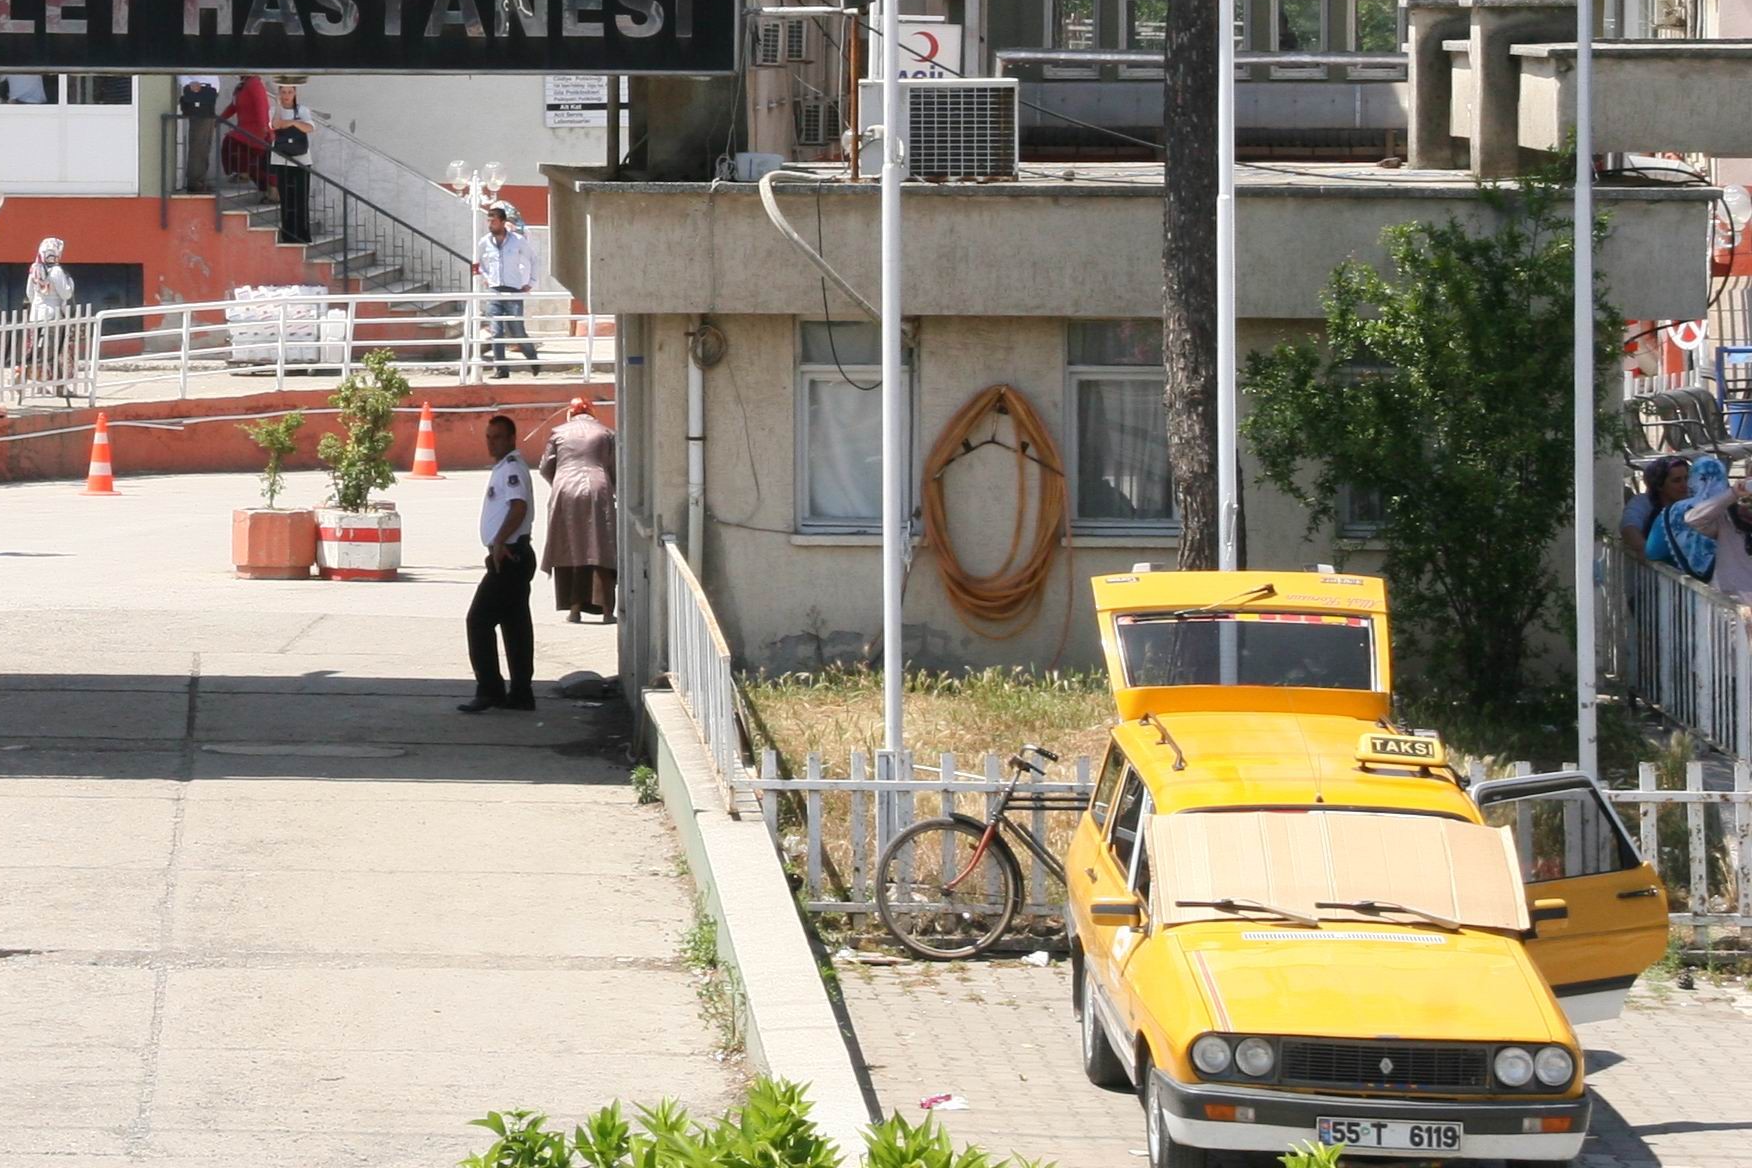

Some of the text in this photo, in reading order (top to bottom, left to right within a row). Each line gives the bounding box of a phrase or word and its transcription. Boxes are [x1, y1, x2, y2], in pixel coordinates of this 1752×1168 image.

[1371, 739, 1433, 755] TAKSI
[1332, 1121, 1458, 1148] 55 T 6119
